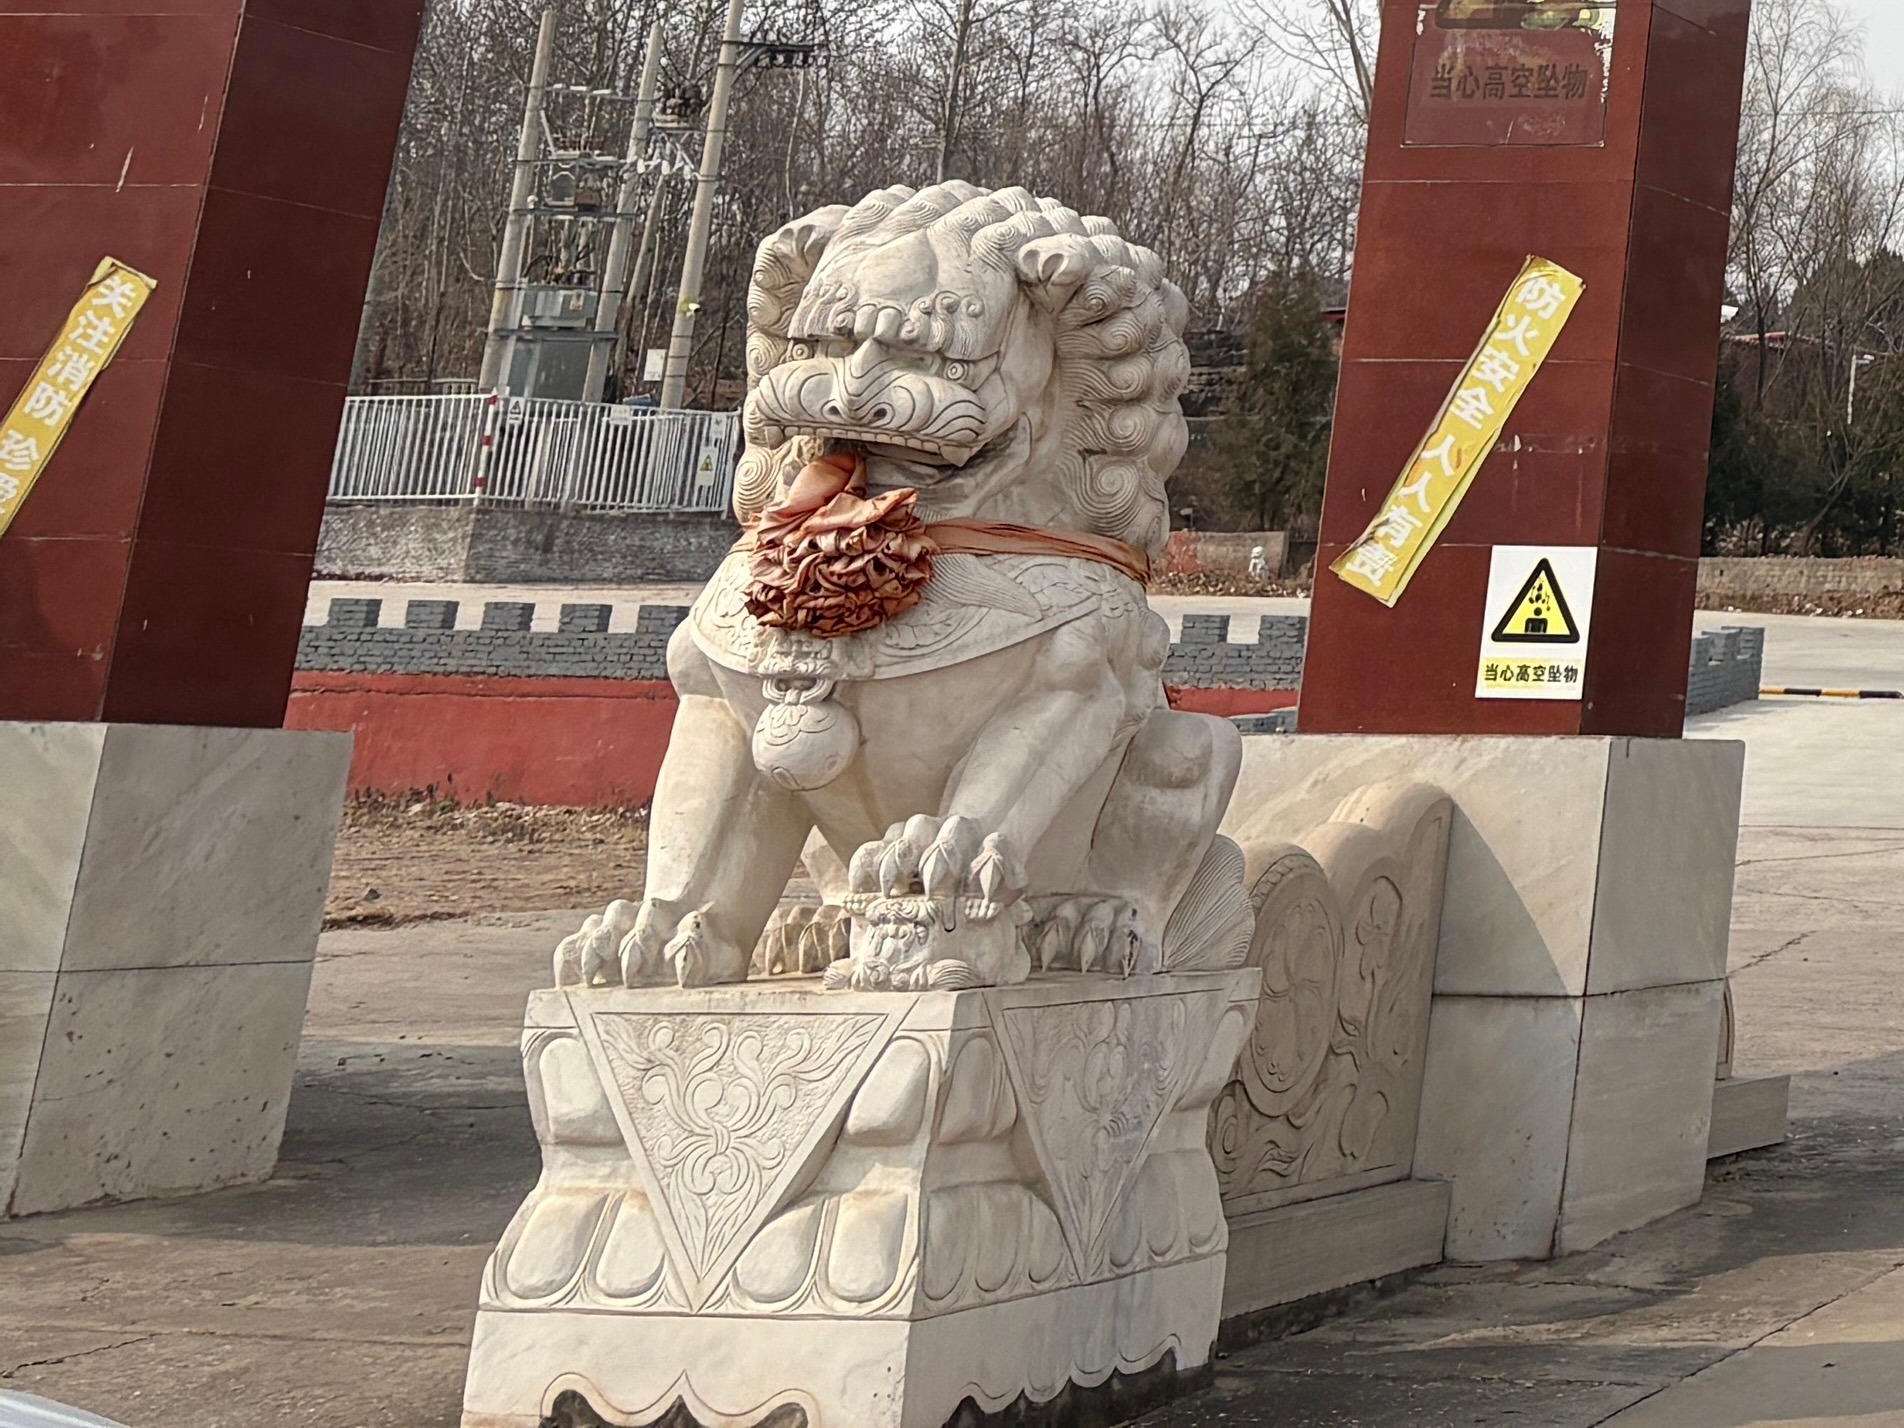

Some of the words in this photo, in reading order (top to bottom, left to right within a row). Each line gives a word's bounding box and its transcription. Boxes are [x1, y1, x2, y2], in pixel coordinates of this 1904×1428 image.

[1430, 63, 1589, 101] 当心高空坠物
[1450, 277, 1567, 430] 防火安全
[1484, 662, 1579, 683] 当心高空坠物
